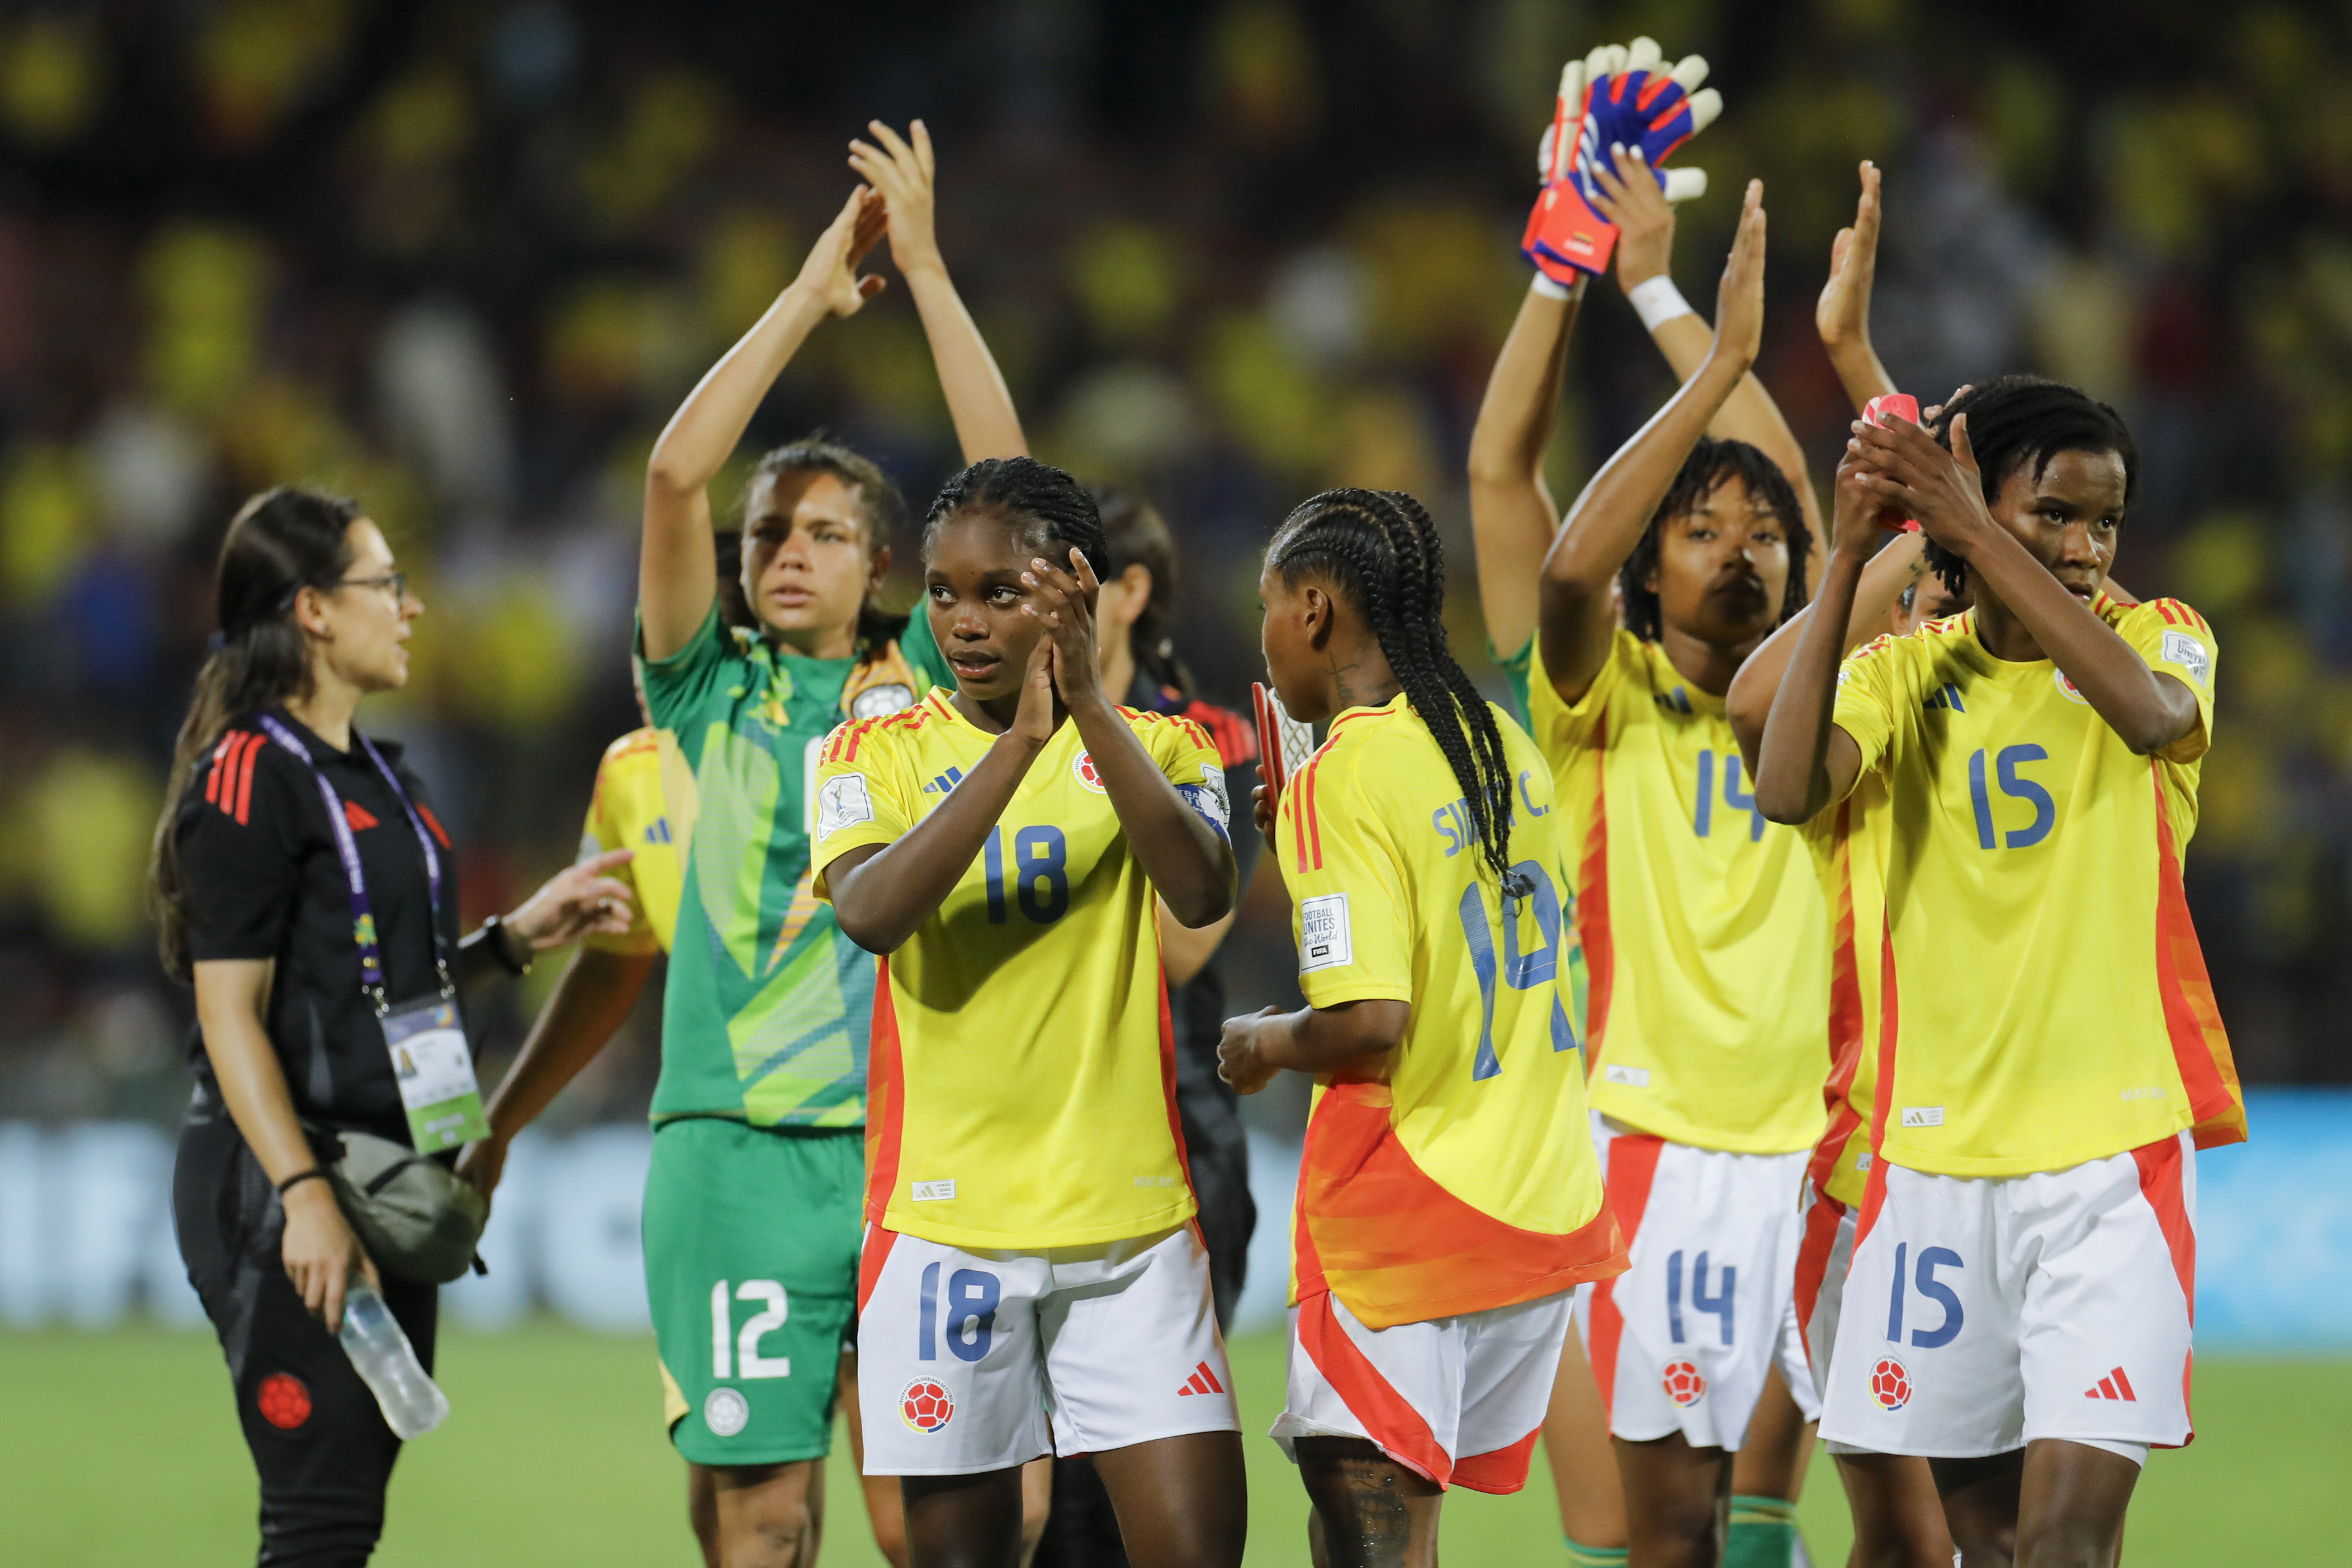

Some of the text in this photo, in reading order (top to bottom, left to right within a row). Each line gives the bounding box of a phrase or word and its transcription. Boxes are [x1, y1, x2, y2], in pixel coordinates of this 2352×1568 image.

[1519, 769, 1549, 816] C.
[1695, 749, 1766, 842] 14
[1968, 743, 2056, 849] 15
[985, 825, 1069, 925] 18
[1303, 907, 1334, 922] FOOTBALL
[1303, 917, 1335, 935] UNITES
[1313, 948, 1328, 956] FIFA
[1314, 930, 1338, 944] World
[1459, 859, 1577, 1081] 19
[711, 1279, 791, 1379] 12
[919, 1261, 1000, 1362] 18
[1667, 1250, 1736, 1345] 14
[1887, 1242, 1964, 1349] 15
